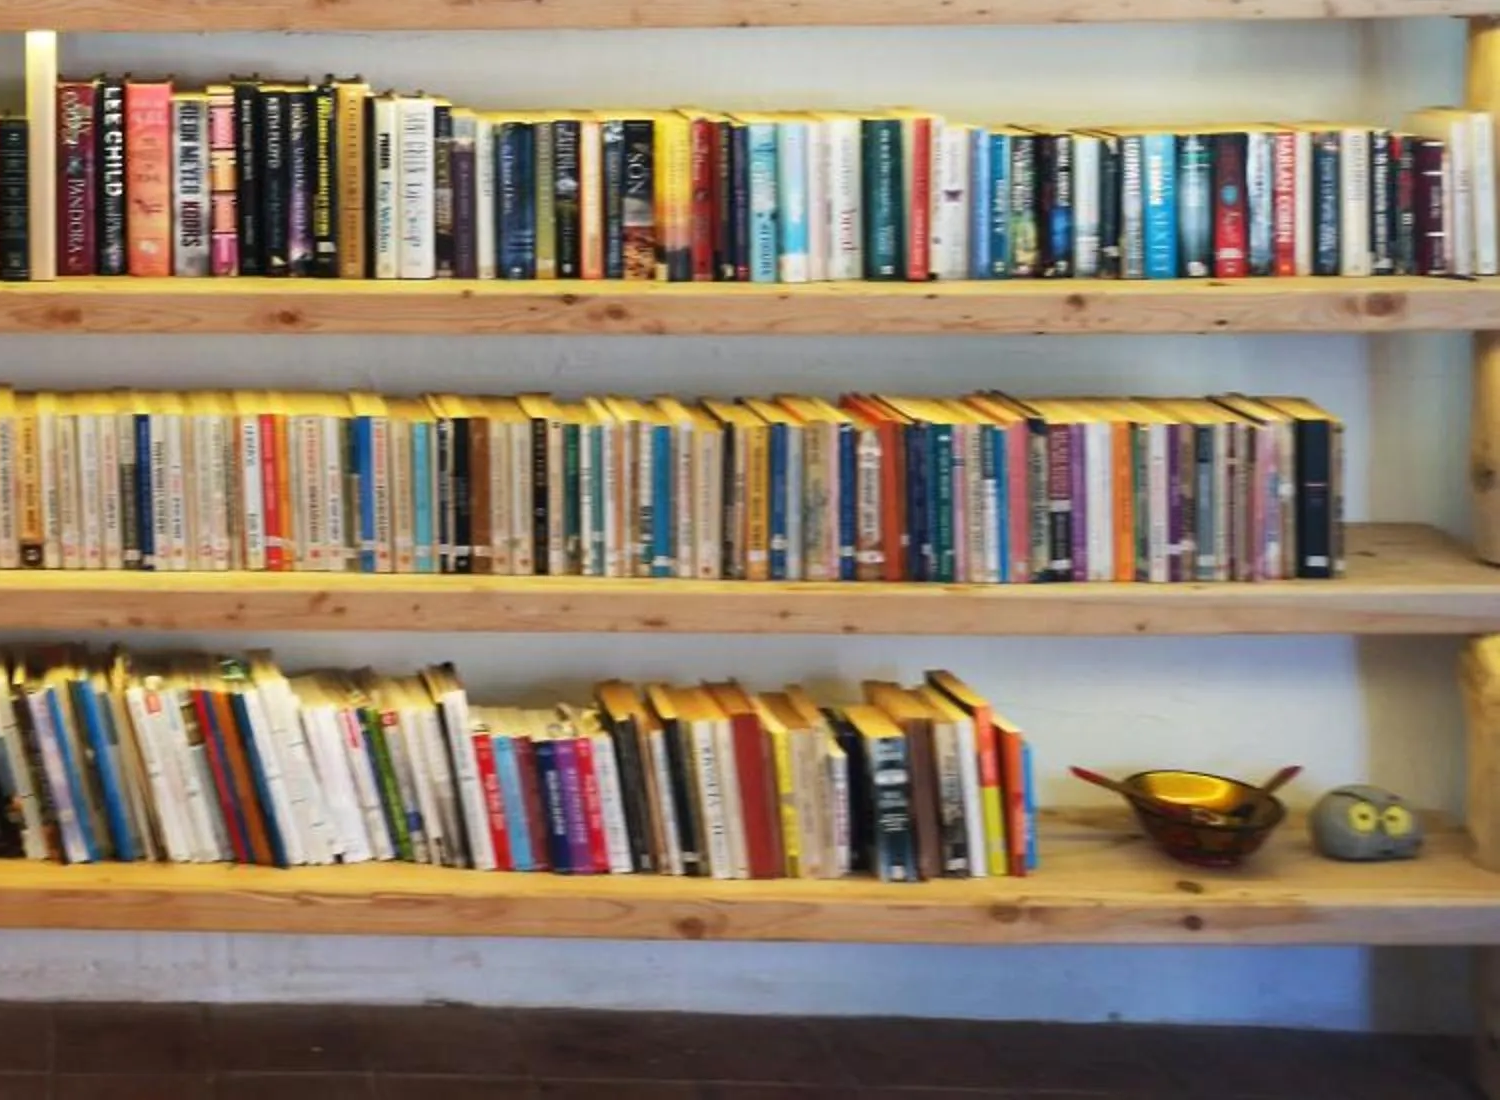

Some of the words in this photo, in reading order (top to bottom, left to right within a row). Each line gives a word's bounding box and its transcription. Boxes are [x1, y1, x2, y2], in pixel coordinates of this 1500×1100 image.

[103, 86, 123, 125] LEE
[179, 106, 202, 142] DEON
[103, 130, 123, 198] CHILD
[179, 146, 202, 194] MEYER
[1277, 136, 1295, 191] HARLAN
[66, 179, 86, 254] PANDORA
[180, 201, 202, 248] KOORS
[1277, 195, 1295, 243] COBEN
